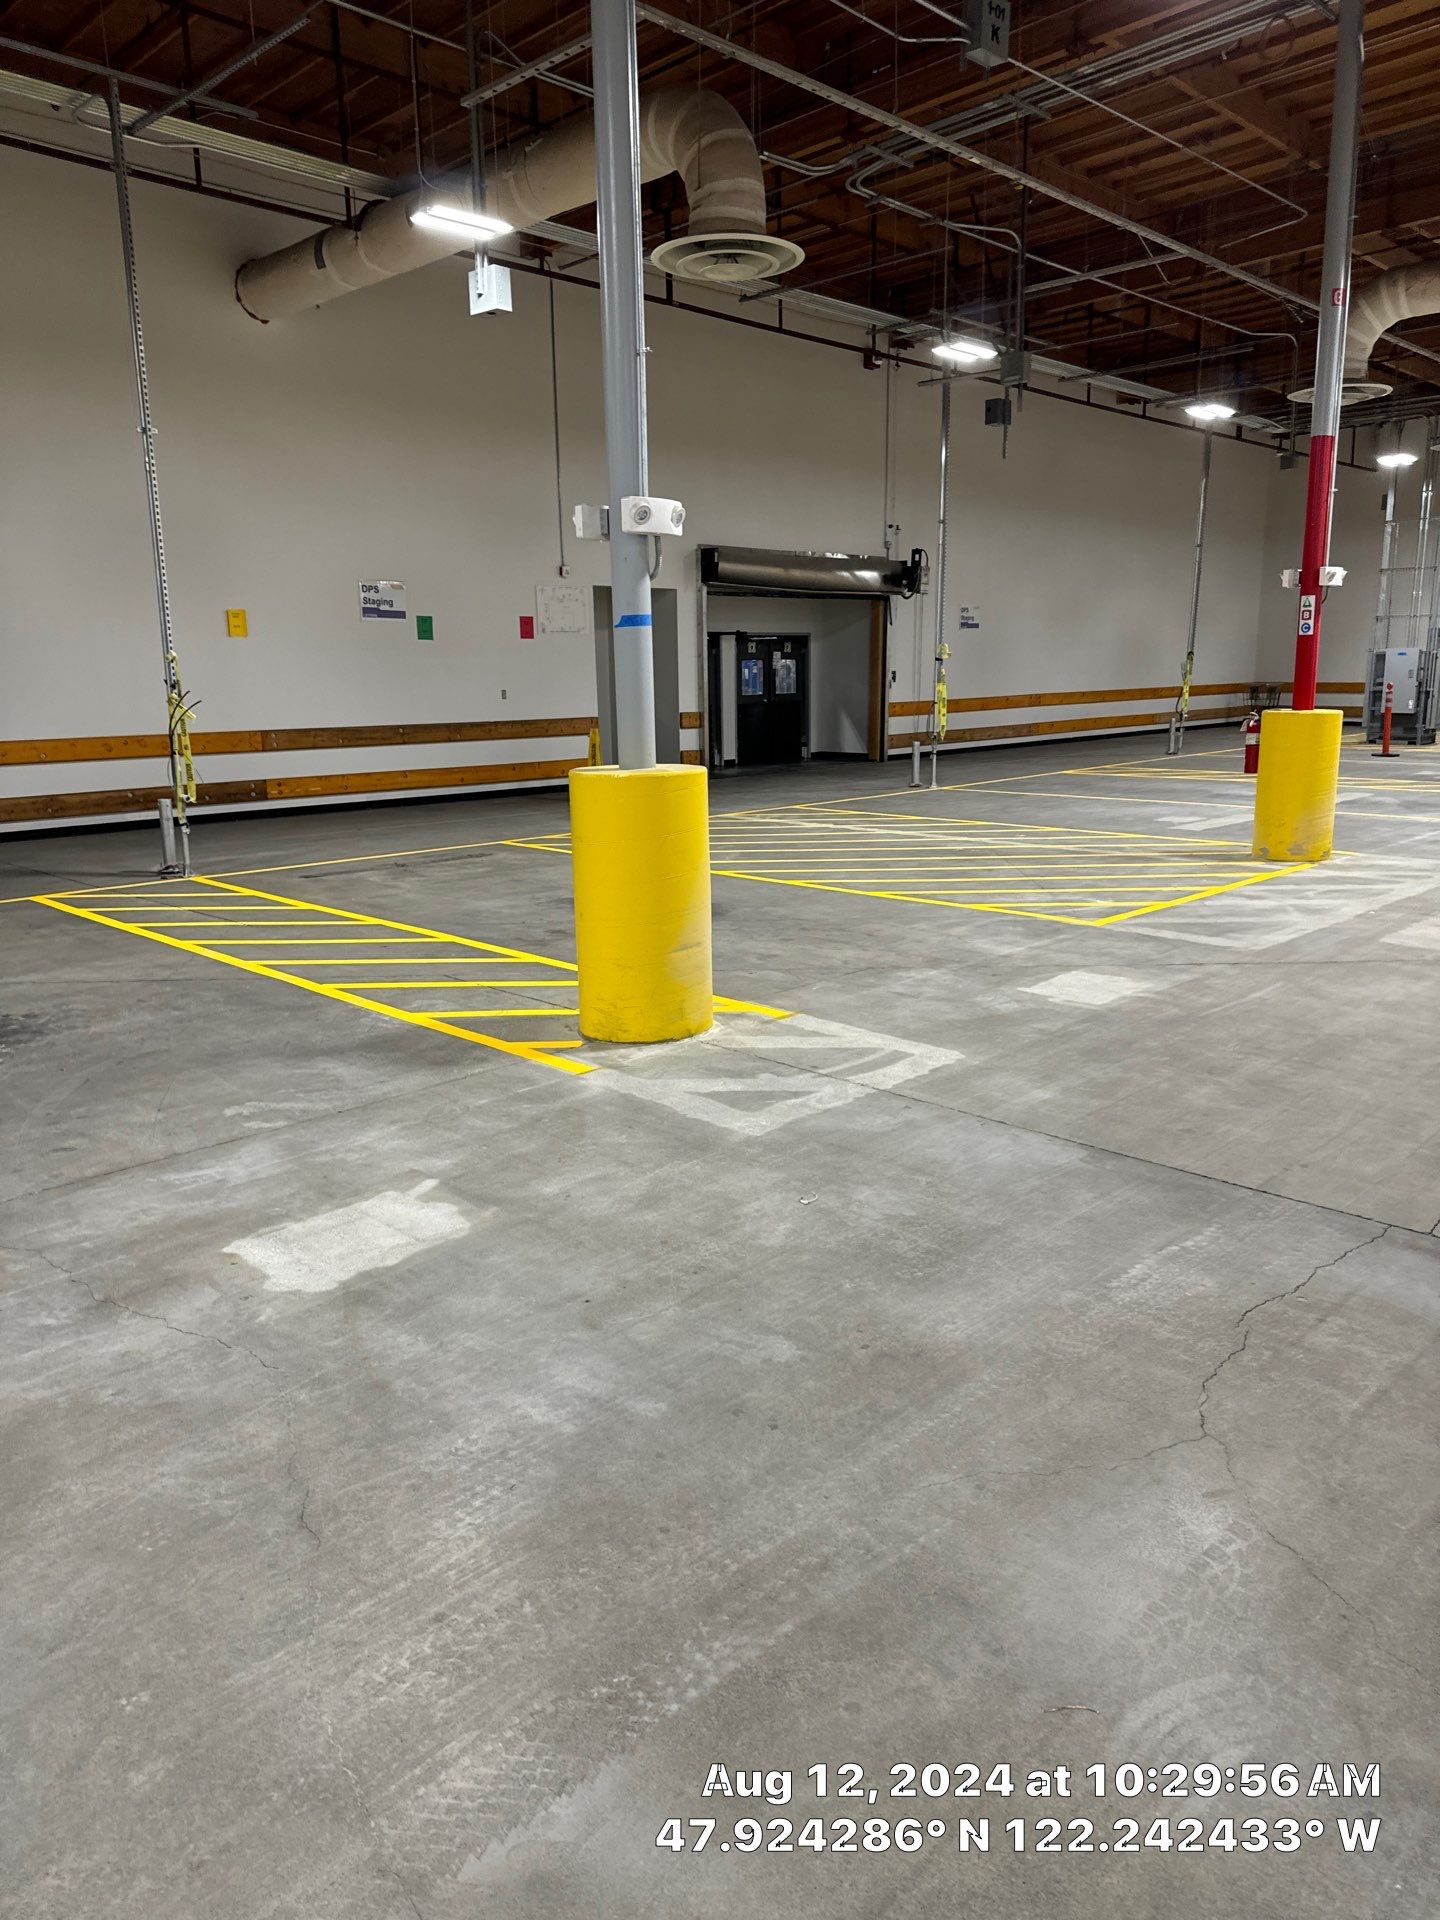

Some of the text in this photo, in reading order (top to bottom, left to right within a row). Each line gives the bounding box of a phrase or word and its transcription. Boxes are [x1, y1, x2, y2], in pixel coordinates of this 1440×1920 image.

[991, 23, 1000, 45] K
[361, 584, 380, 594] DPS
[362, 596, 394, 608] Staging
[185, 763, 194, 782] CAUTION
